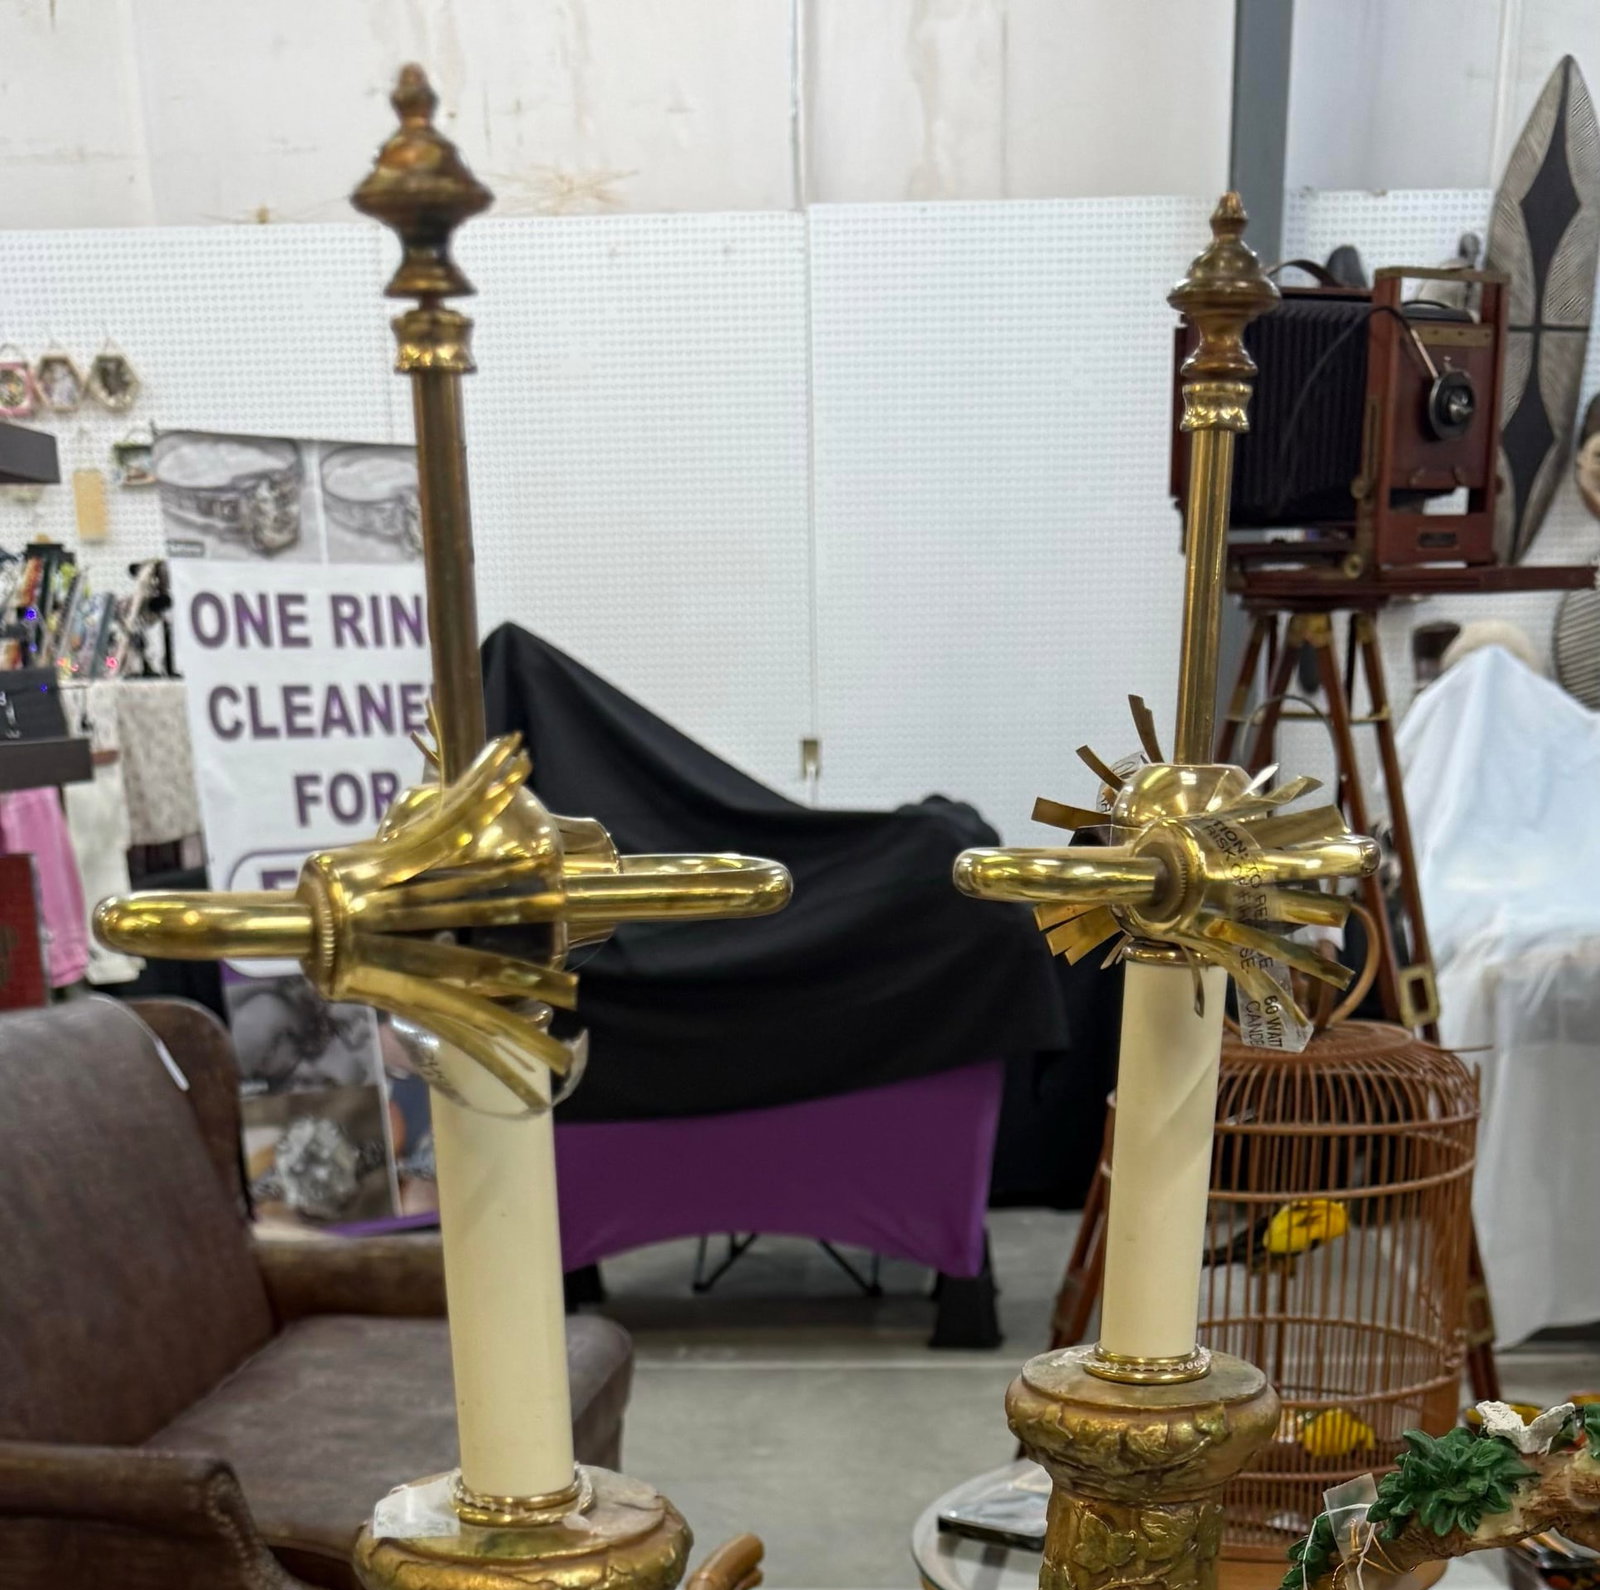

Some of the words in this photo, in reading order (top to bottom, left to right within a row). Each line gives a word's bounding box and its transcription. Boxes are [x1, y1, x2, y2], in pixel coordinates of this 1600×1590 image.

[189, 591, 312, 649] ONE
[330, 593, 425, 649] RIN
[207, 683, 436, 741] CLEANE
[293, 771, 401, 829] FOR
[1202, 825, 1236, 862] RISK
[1246, 1000, 1265, 1047] CANDE
[1266, 1017, 1283, 1048] WATT
